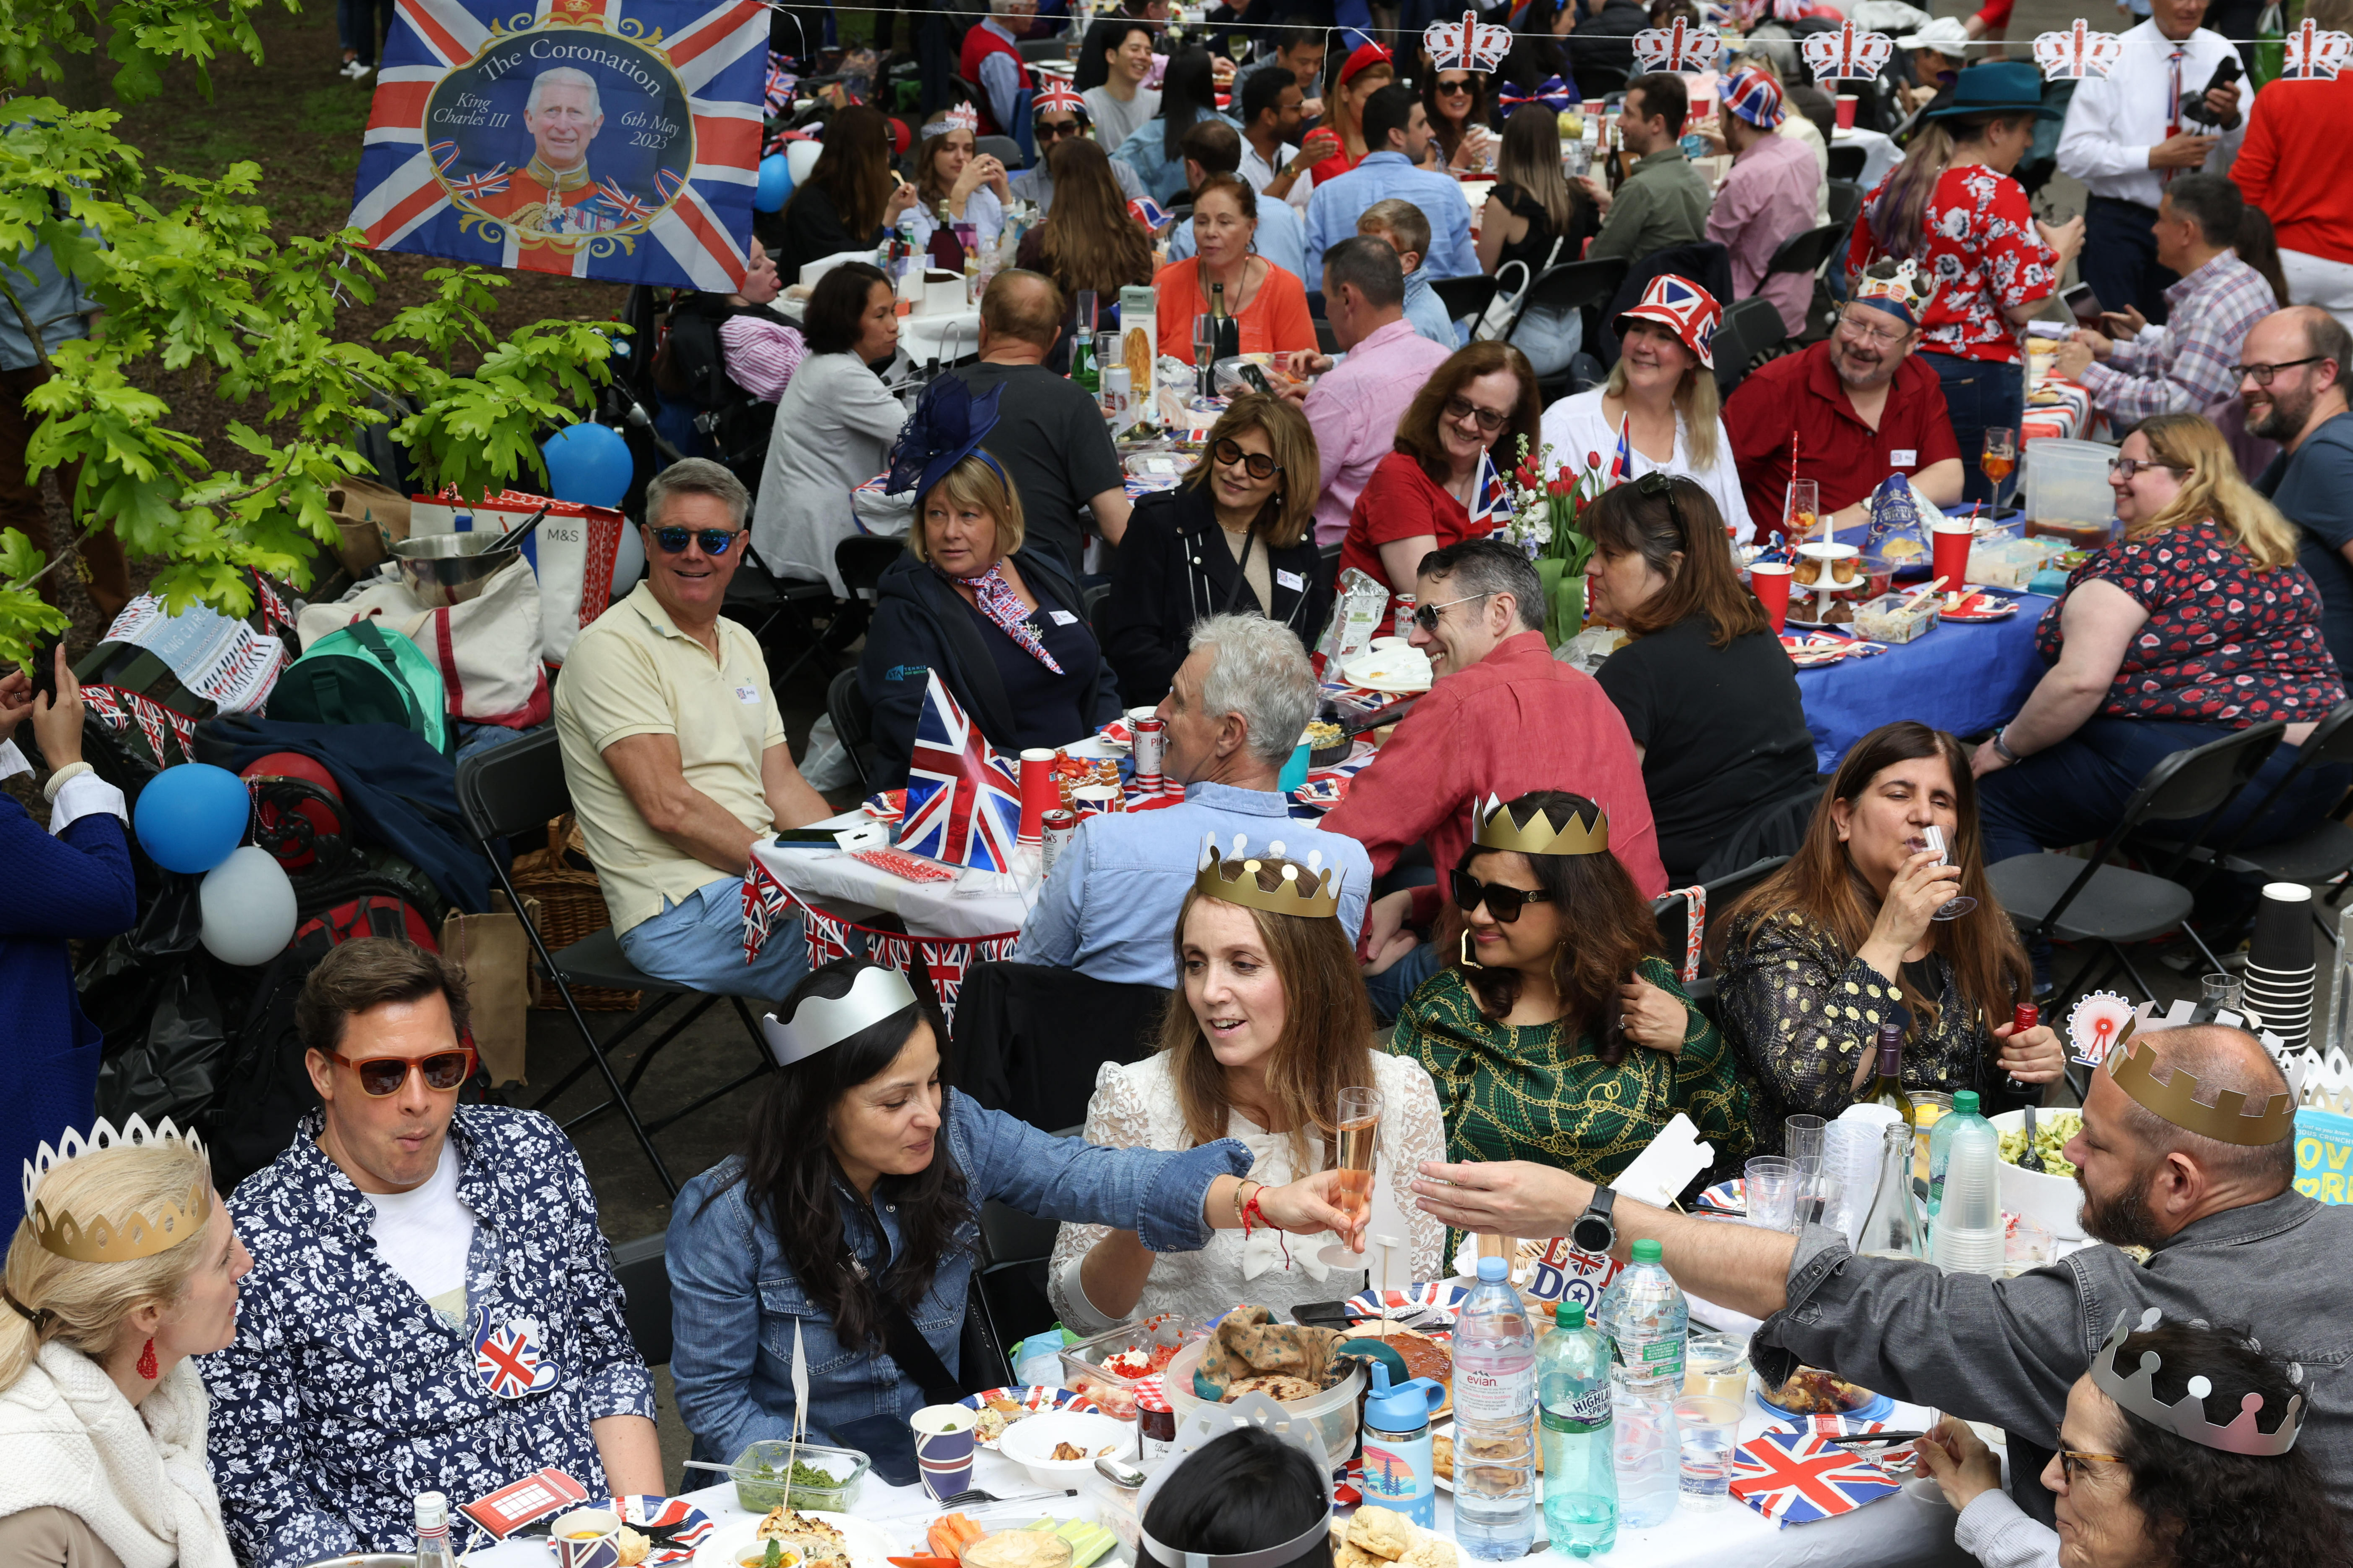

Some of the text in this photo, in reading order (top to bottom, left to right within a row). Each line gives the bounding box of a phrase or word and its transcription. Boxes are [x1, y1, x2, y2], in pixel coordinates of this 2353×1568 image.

[478, 38, 660, 99] The Coronation
[456, 92, 493, 113] King
[433, 107, 511, 128] Charles III
[621, 110, 679, 138] 6th May
[628, 131, 667, 150] 2023
[547, 529, 579, 542] M&S
[1396, 614, 1414, 623] PIMM
[161, 602, 212, 656] KING CHARLE
[1042, 834, 1057, 844] MM'S
[2319, 1133, 2353, 1146] CRUNCH
[1658, 1326, 1682, 1336] COMMITMENTS
[1467, 1375, 1496, 1386] evian
[1572, 1387, 1612, 1414] HIGHLAN
[1460, 1404, 1472, 1414] 1.5L
[1588, 1400, 1611, 1416] SPRING
[1589, 1412, 1611, 1425] SPARKLING
[1154, 1442, 1169, 1453] Bon
[544, 1477, 570, 1497] TELEPHONE
